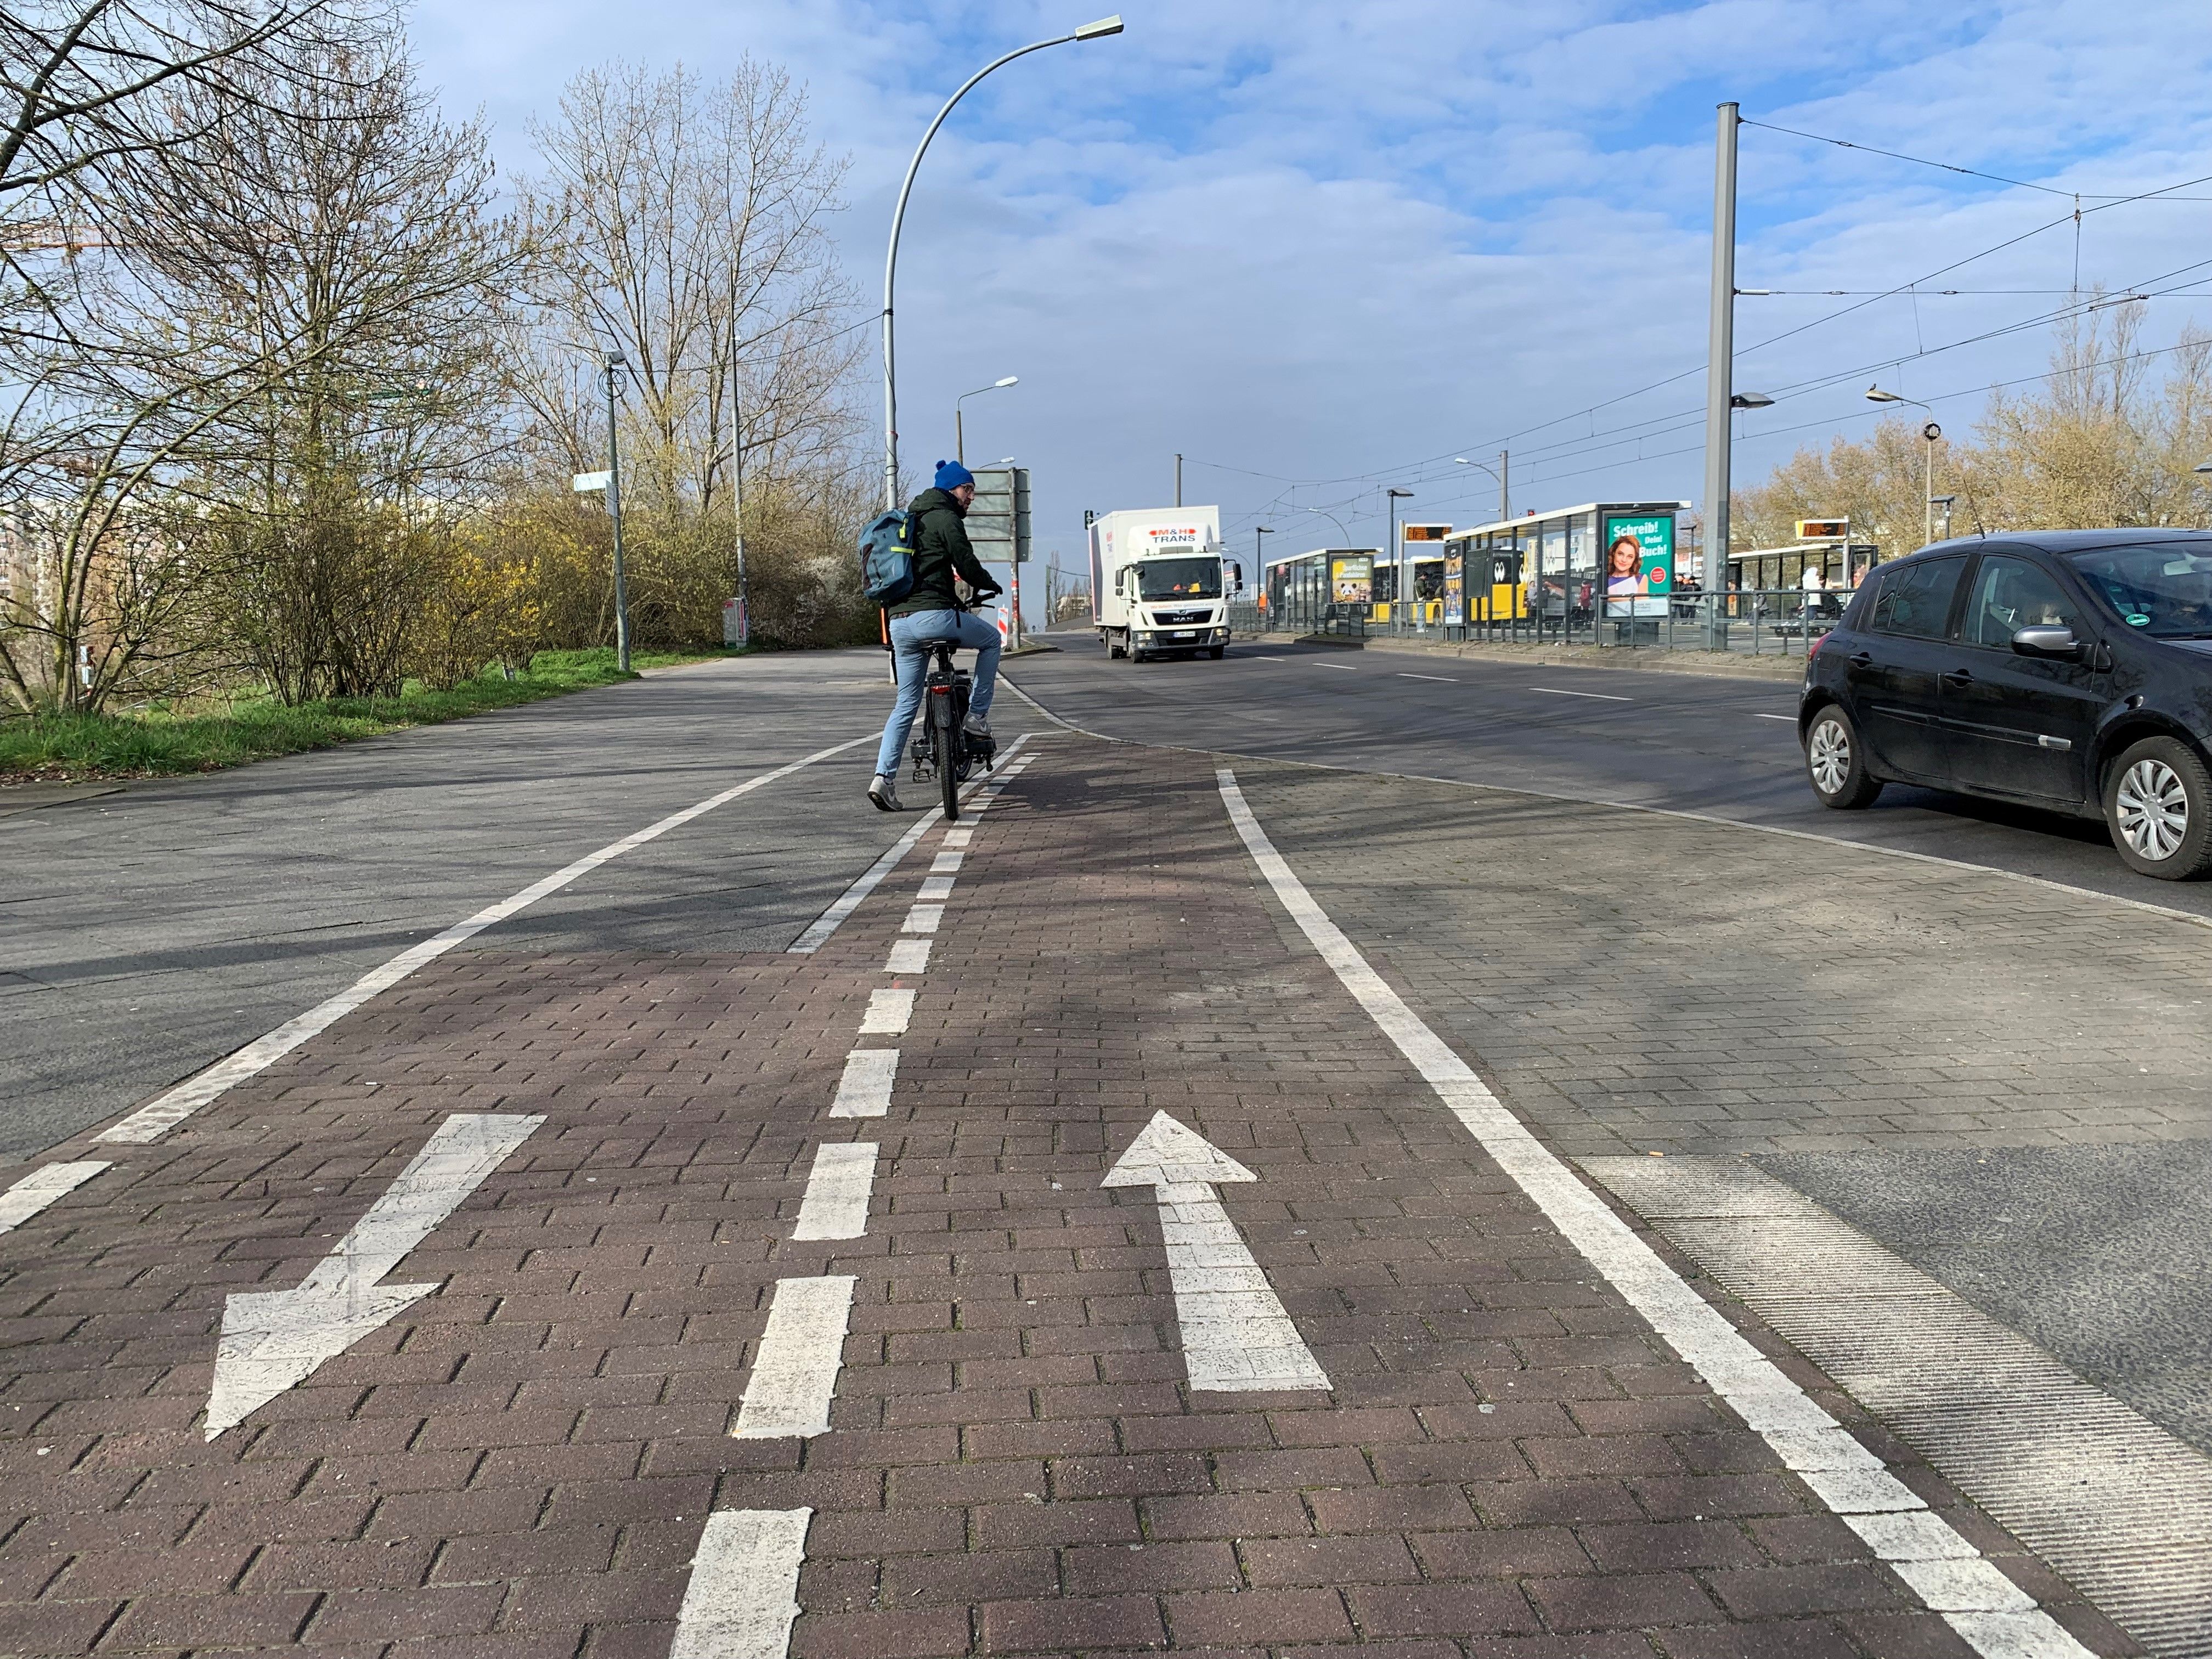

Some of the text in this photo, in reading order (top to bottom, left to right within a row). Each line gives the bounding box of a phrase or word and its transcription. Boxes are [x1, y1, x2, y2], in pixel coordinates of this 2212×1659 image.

[1613, 521, 1658, 537] Schreib!
[1645, 535, 1663, 544] Dein!
[1639, 544, 1667, 557] Buch!
